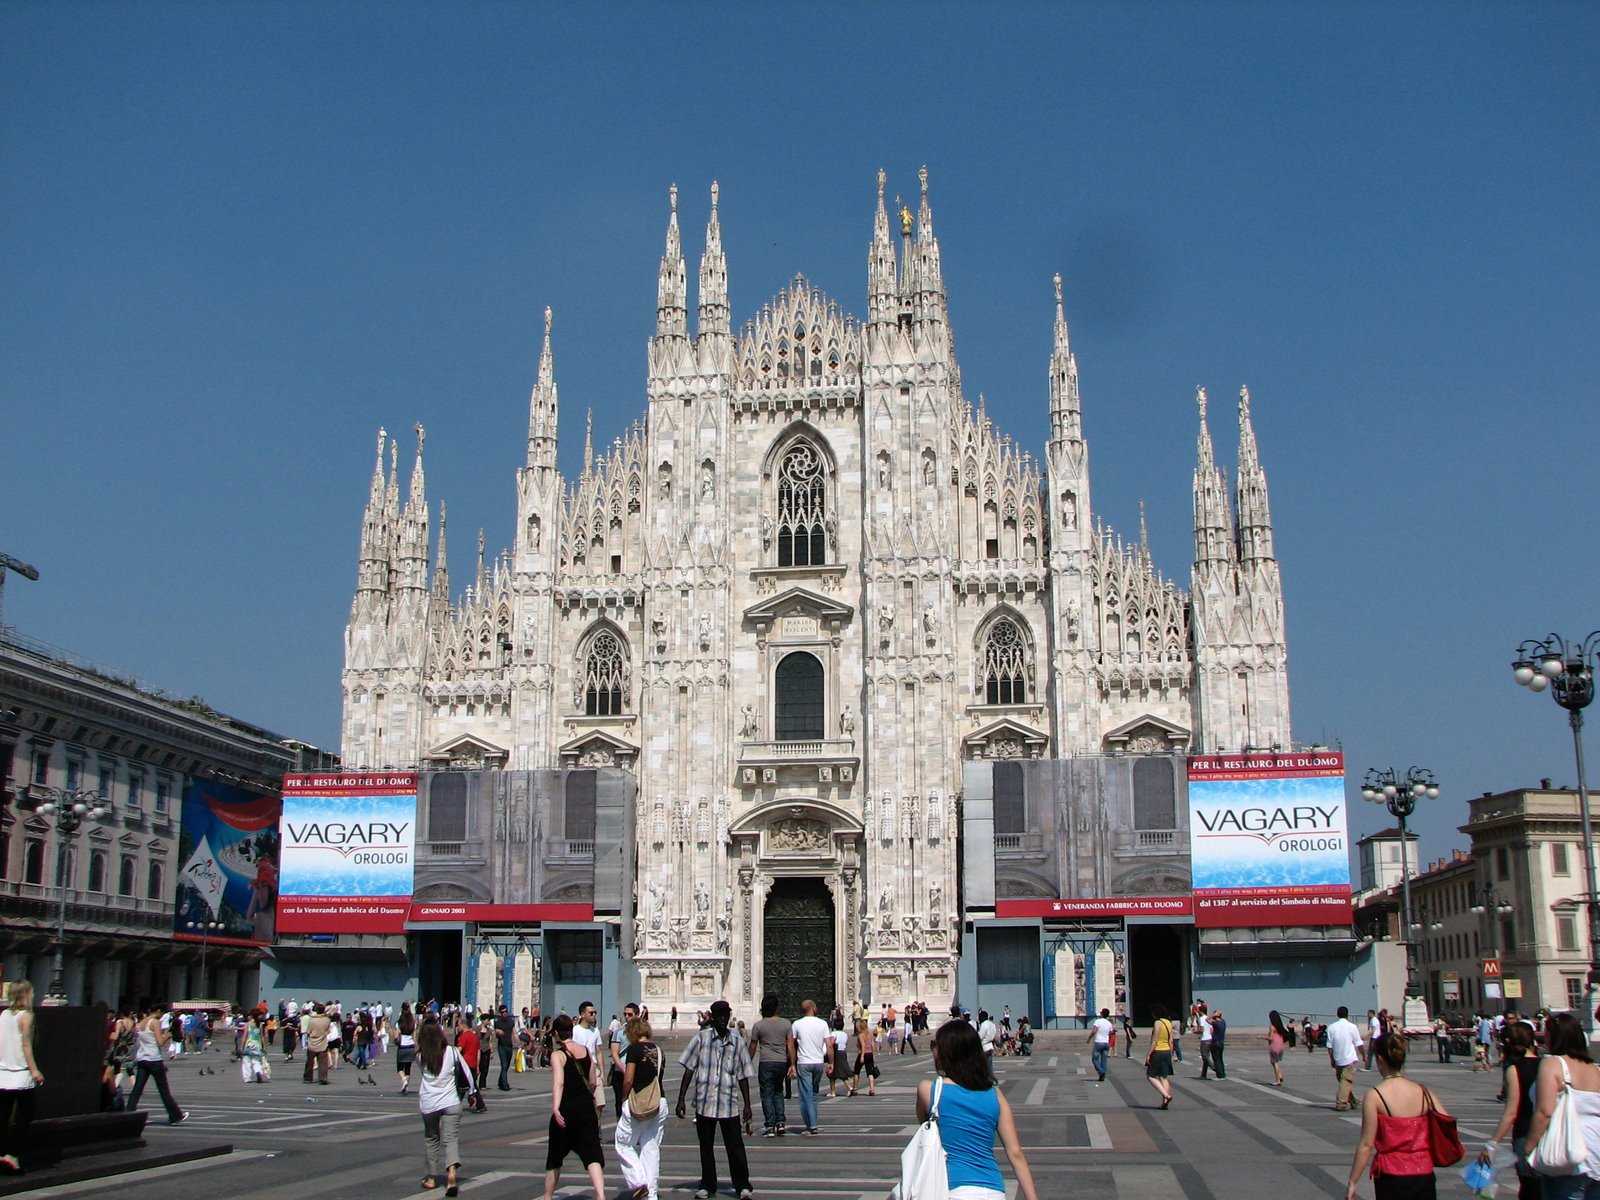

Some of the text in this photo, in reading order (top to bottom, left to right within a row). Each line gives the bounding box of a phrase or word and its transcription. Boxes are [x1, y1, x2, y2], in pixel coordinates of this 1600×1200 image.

[1192, 758, 1338, 769] PER IL RESTAURO DEL DUOMO
[314, 778, 356, 786] RESTAURO
[358, 778, 374, 786] DEL
[376, 778, 412, 786] DUOMO
[1196, 806, 1339, 832] VAGARY
[287, 822, 409, 844] VAGARY
[1279, 838, 1342, 852] OROLOGI
[354, 852, 408, 864] OROLOGI
[1484, 962, 1498, 972] M
